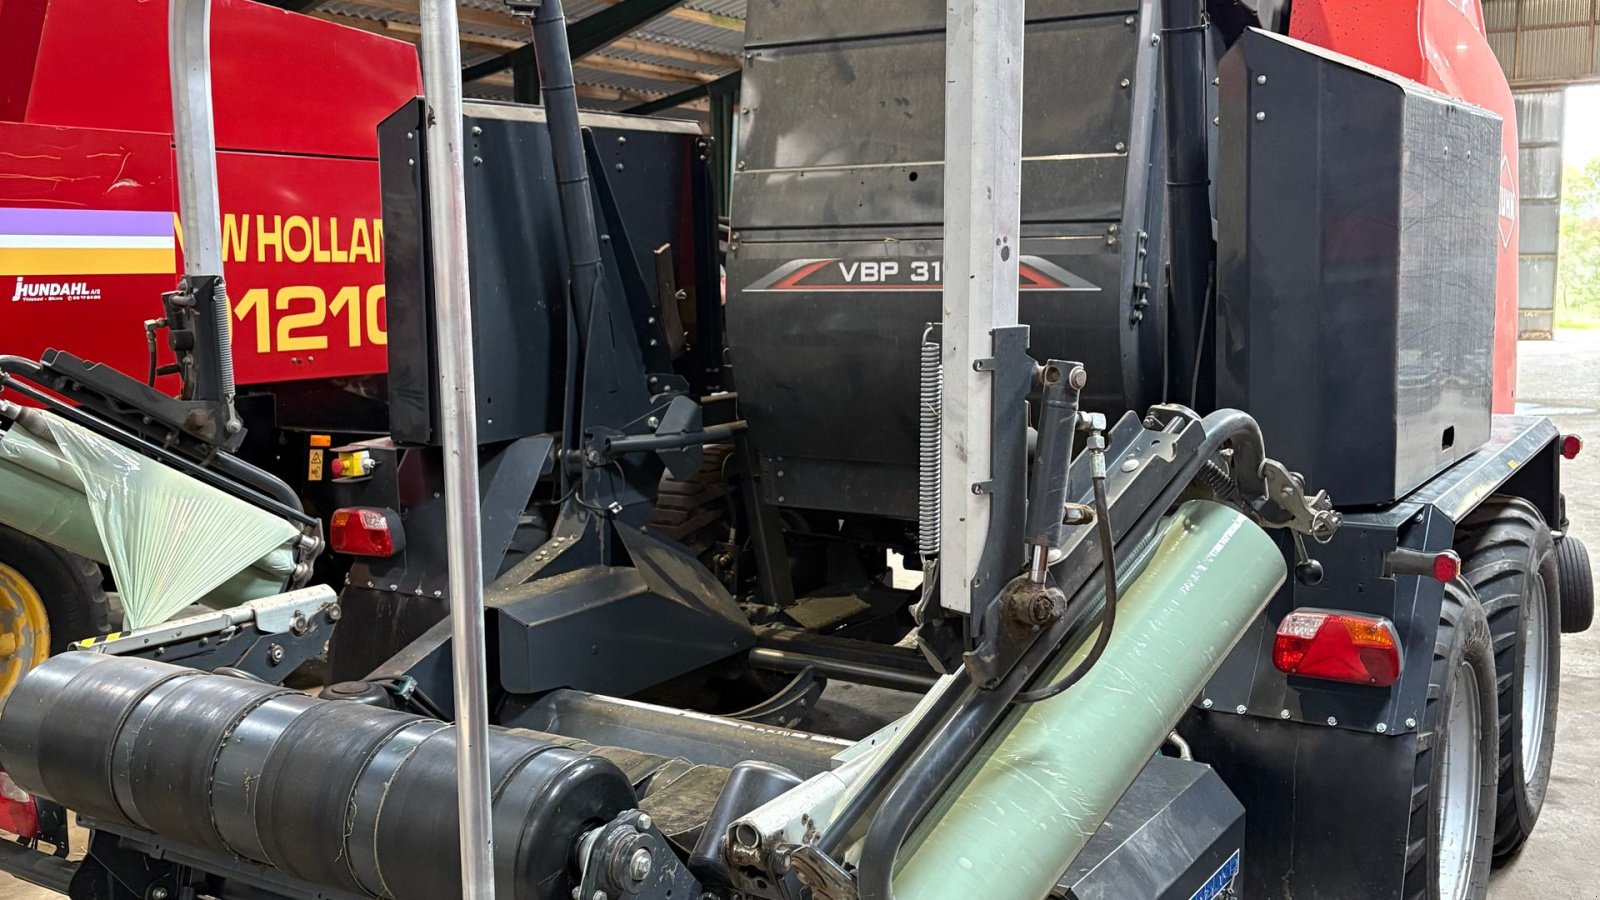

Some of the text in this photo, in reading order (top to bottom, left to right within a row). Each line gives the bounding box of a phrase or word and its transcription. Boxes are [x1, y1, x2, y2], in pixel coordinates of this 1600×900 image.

[1499, 186, 1515, 222] UHN
[838, 261, 944, 282] VBP 31
[228, 284, 388, 354] 121
